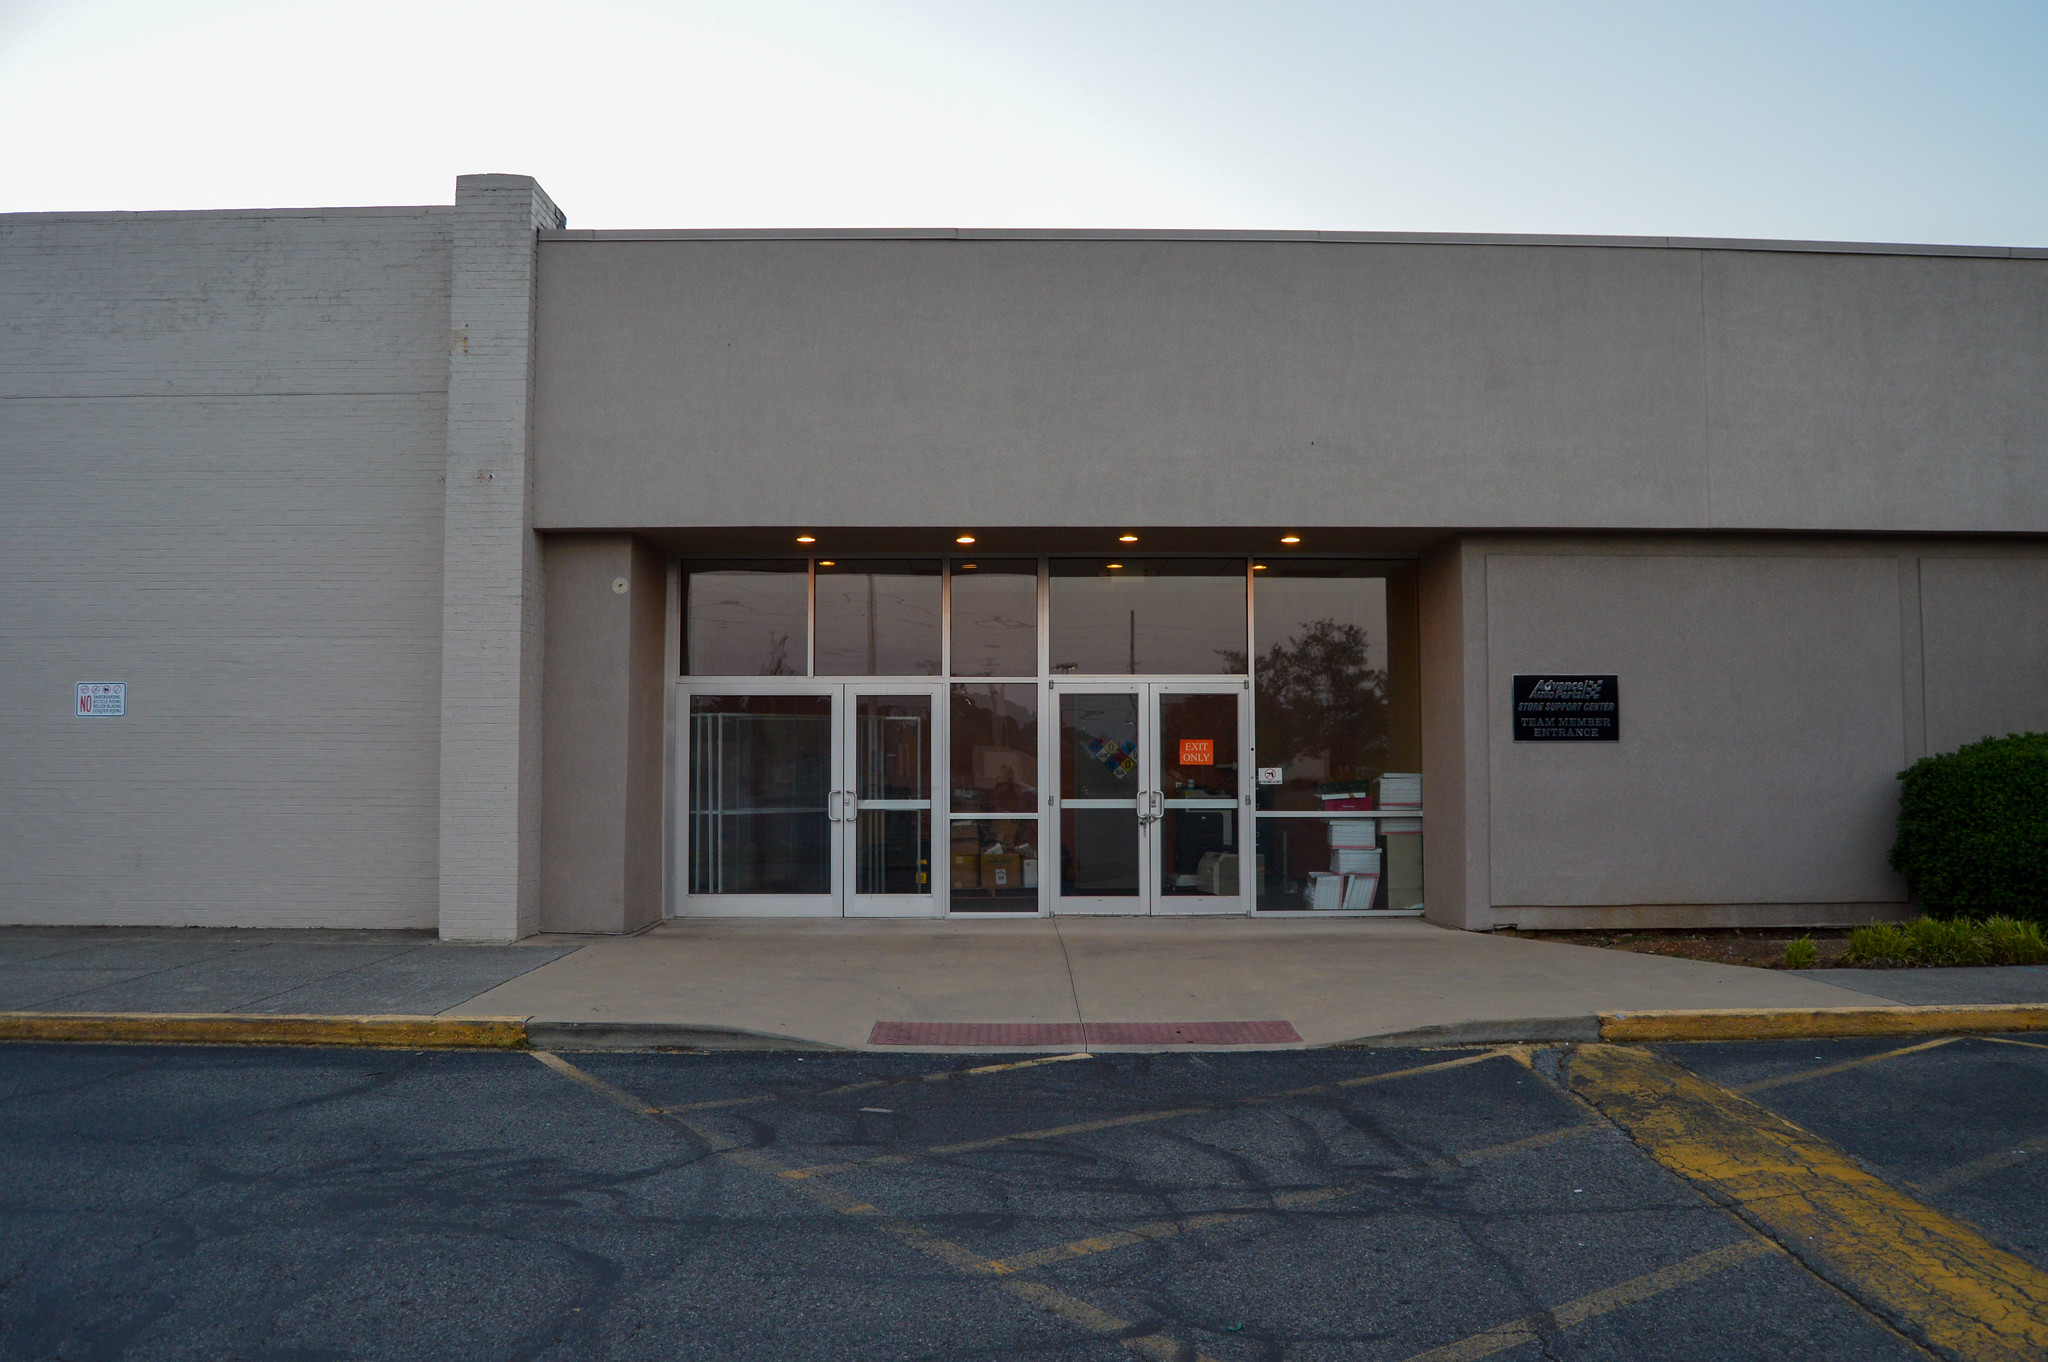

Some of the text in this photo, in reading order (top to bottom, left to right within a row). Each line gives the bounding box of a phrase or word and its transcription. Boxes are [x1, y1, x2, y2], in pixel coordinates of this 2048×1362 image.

[1535, 680, 1583, 690] Advance
[1529, 690, 1581, 699] Auto Parts
[80, 696, 92, 712] NO
[1518, 702, 1614, 711] STORE SUPPORT CENTER
[1521, 718, 1611, 726] TEAM MEMBER
[1534, 728, 1598, 736] ENTRANCE
[1185, 743, 1208, 751] EXIT
[1183, 754, 1210, 762] ONLY
